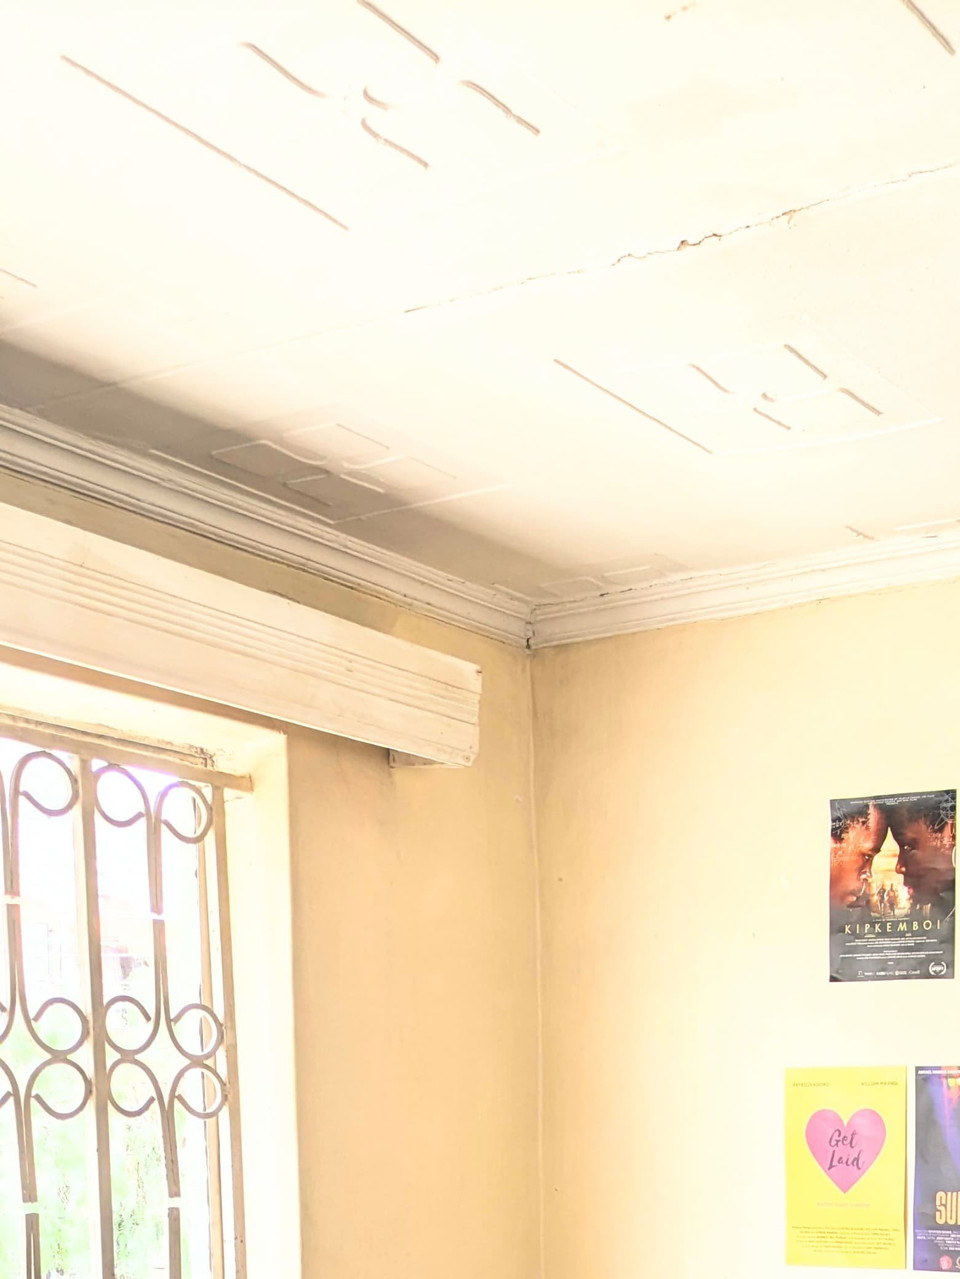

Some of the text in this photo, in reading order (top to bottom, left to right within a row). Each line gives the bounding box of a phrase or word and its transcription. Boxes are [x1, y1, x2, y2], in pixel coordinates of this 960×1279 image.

[844, 919, 941, 934] KIPKEMBOI
[828, 1128, 858, 1149] Get
[827, 1149, 866, 1171] Laid
